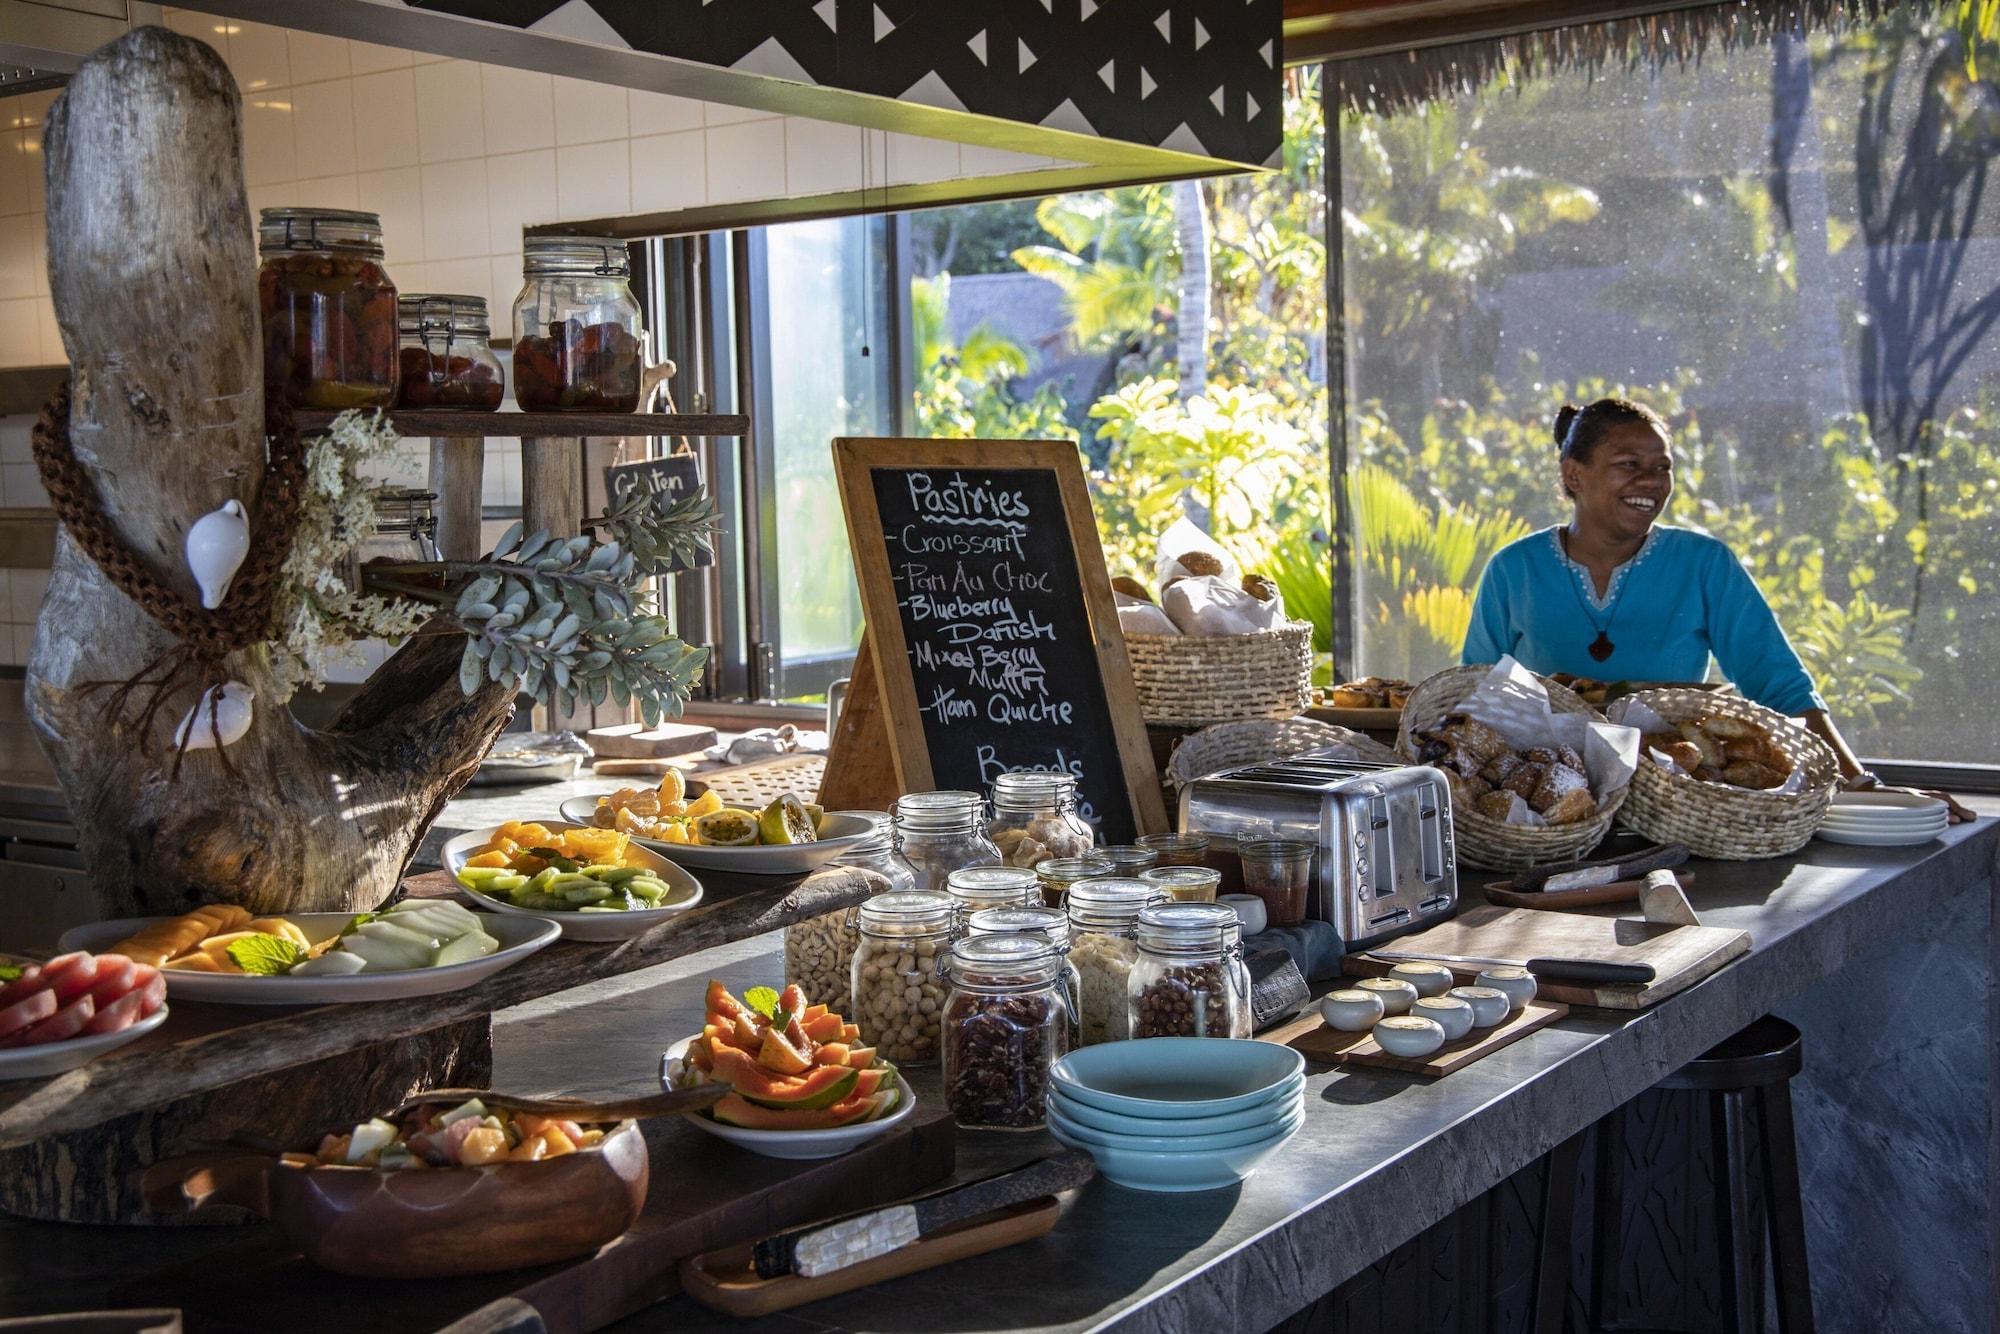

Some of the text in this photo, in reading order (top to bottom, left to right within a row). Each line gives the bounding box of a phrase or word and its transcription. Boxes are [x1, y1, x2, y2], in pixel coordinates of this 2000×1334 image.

[906, 471, 1030, 517] Pastries
[952, 560, 985, 595] Au
[992, 561, 1053, 592] Choc
[937, 609, 1057, 644] Danish
[976, 645, 1047, 674] Berry
[968, 662, 1049, 699] Muffin
[987, 692, 1073, 726] Quiche
